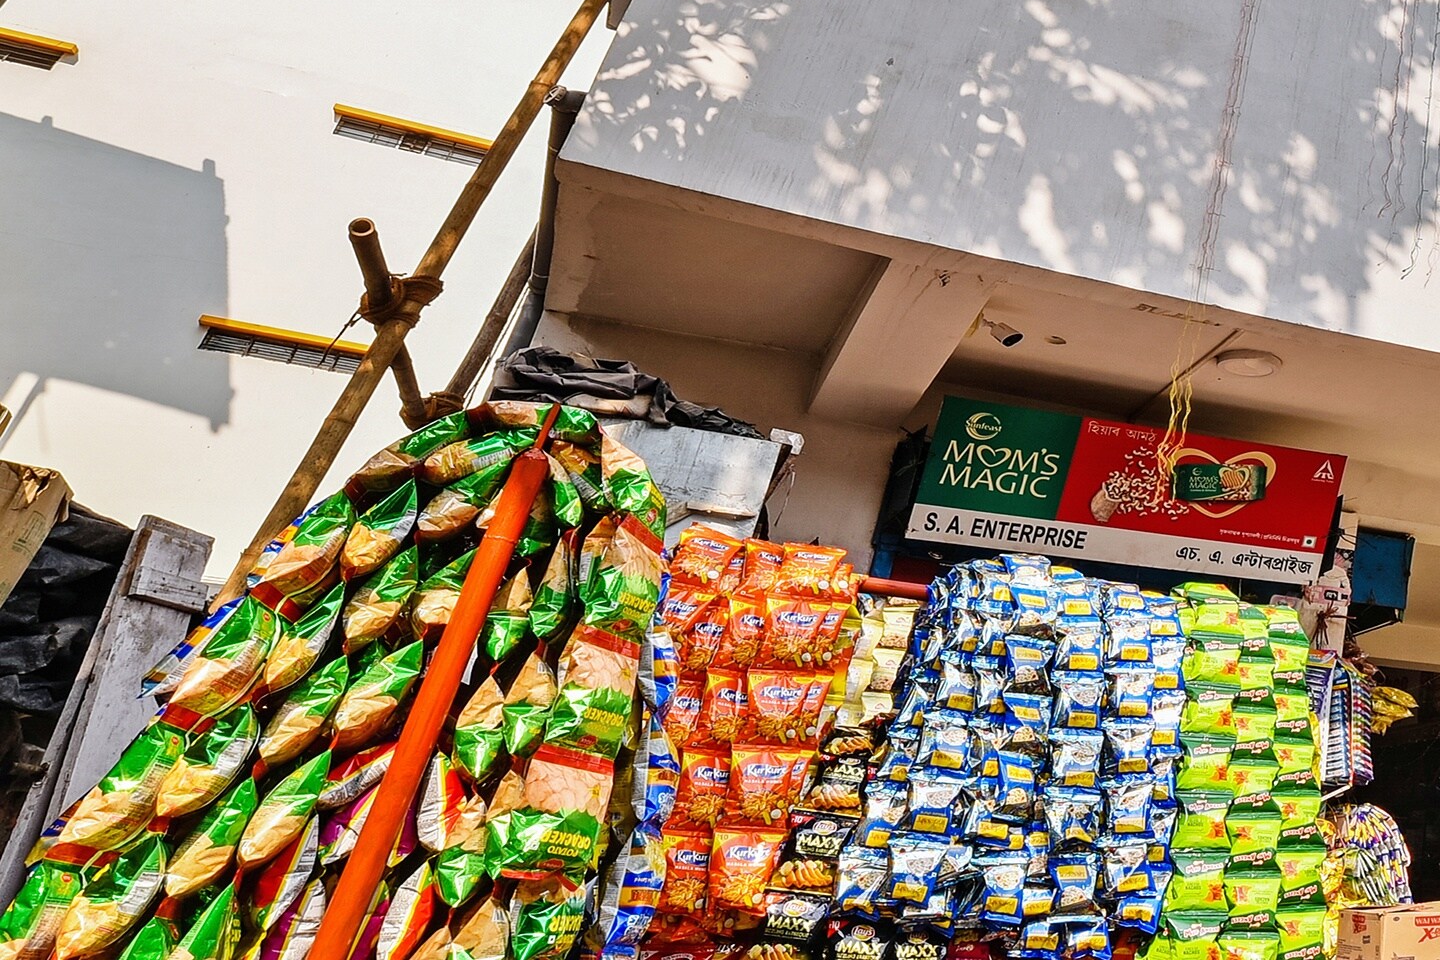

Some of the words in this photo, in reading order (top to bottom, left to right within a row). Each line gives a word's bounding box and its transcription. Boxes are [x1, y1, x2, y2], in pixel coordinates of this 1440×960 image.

[965, 418, 1002, 433] Sunfeast
[939, 463, 1050, 498] MAGIC
[924, 512, 940, 532] S.
[946, 515, 964, 535] A.
[970, 518, 1088, 549] ENTERPRISE
[692, 537, 729, 551] Kurkure
[620, 591, 655, 613] CRACKER
[778, 612, 818, 627] Kurkure
[760, 685, 802, 700] Kurkure
[584, 707, 624, 726] CRACKER
[743, 764, 787, 779] Kurkure
[799, 833, 845, 851] MAXX
[547, 845, 578, 857] POTATO
[767, 915, 816, 933] MAXX
[852, 926, 873, 938] Lay's
[837, 941, 885, 956] MAXX
